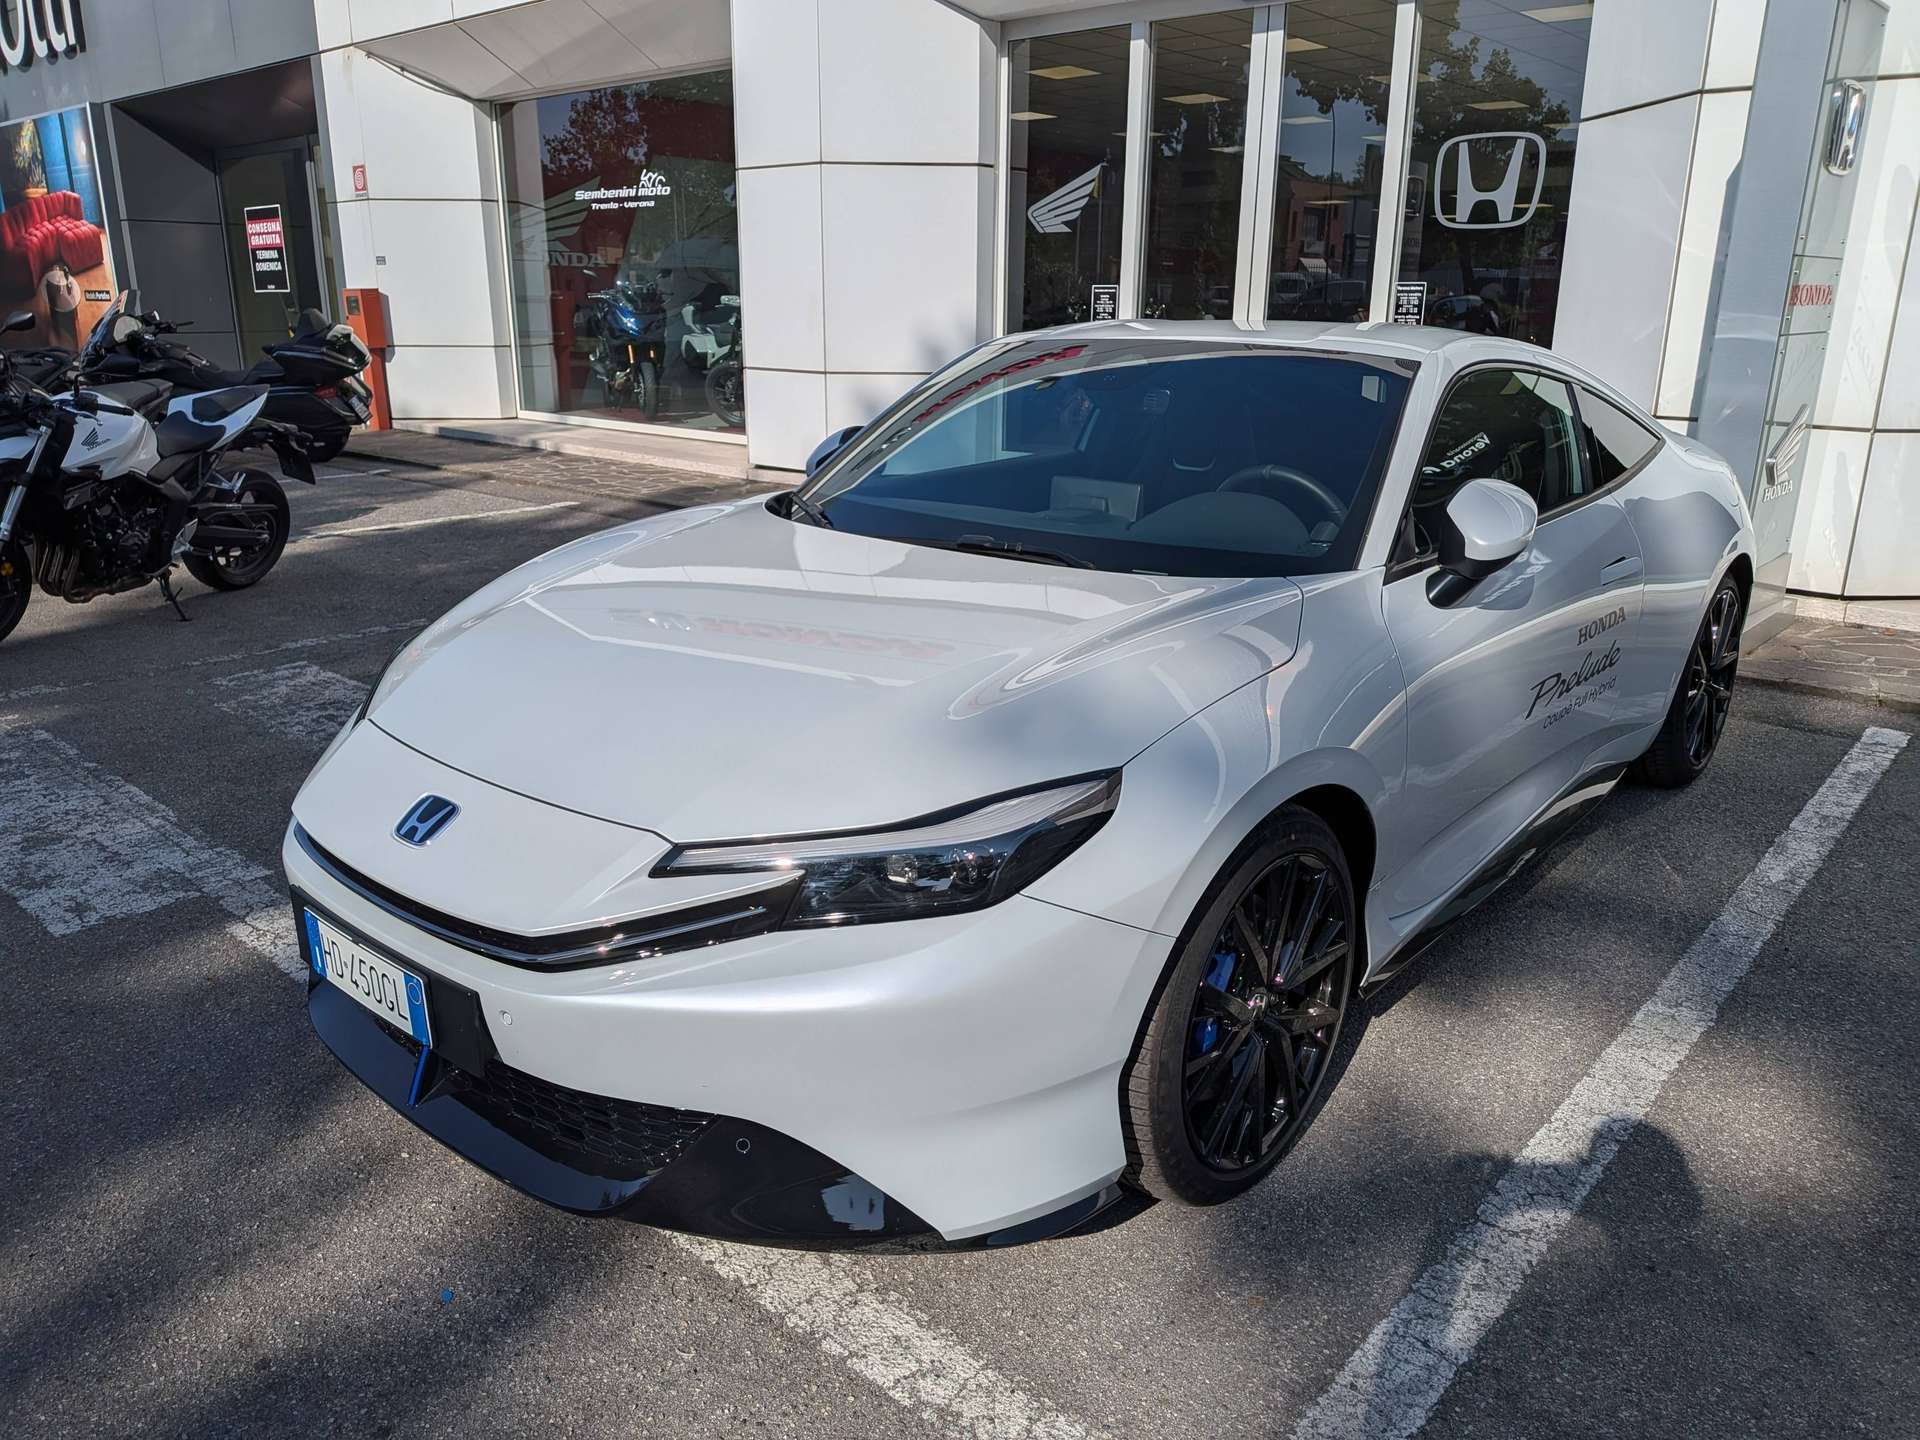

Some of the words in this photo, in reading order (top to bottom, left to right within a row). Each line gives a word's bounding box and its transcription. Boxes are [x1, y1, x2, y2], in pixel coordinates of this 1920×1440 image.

[575, 186, 636, 200] Sembenini
[638, 184, 671, 196] moto
[591, 202, 618, 210] Trento
[248, 221, 281, 234] CONSEGNA
[251, 234, 281, 245] GRATUITA
[256, 249, 279, 260] TERMINA
[256, 261, 282, 271] DOMENICA
[1762, 479, 1793, 503] HONDA
[1576, 606, 1627, 647] HONDA
[1524, 639, 1621, 721] Prelude
